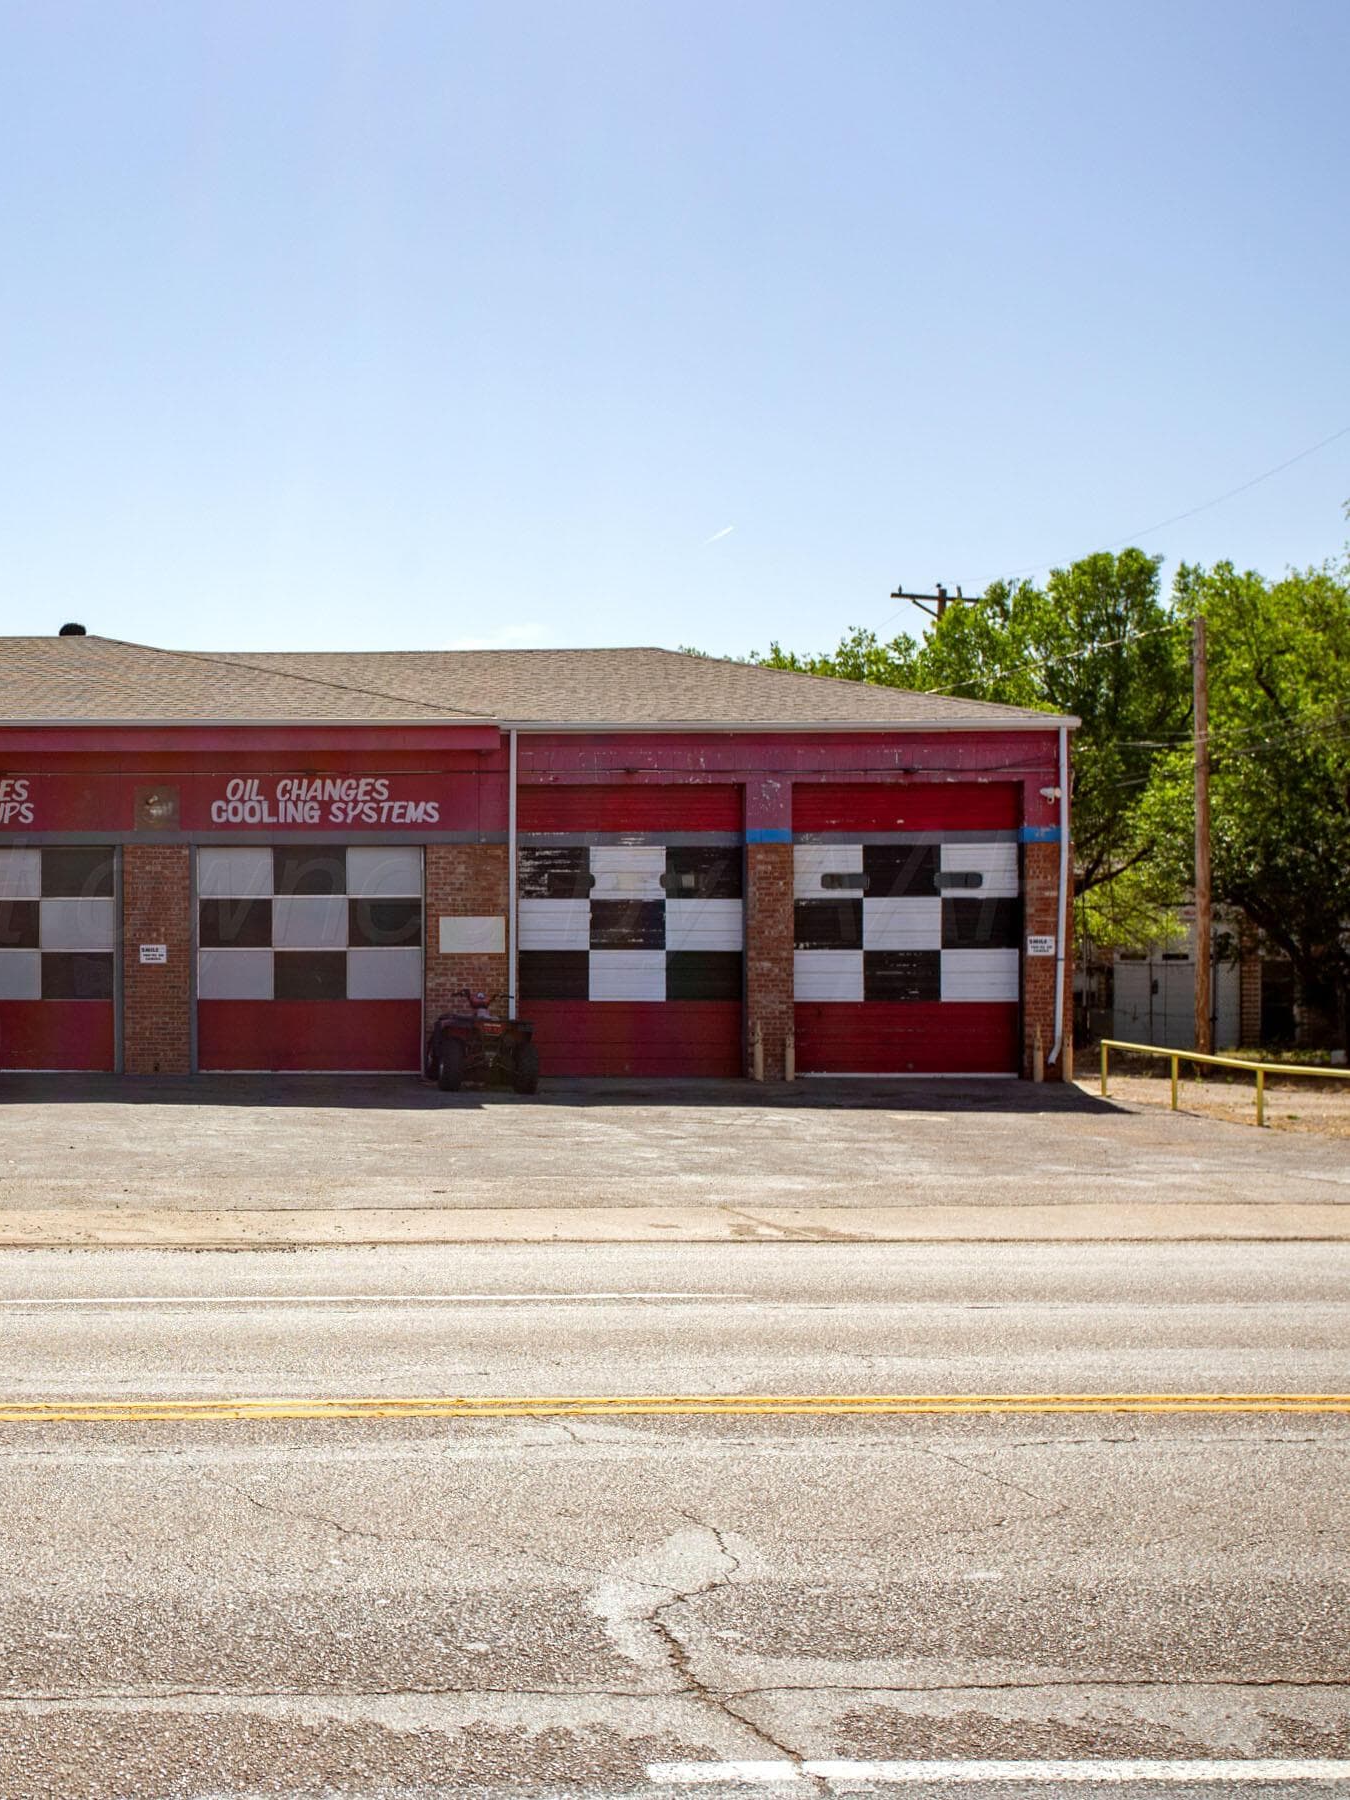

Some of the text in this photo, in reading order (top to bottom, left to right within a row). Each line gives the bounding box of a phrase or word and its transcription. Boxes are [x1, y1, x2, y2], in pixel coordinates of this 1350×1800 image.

[226, 778, 389, 801] OIL CHANGES
[211, 801, 440, 824] COOLING SYSTEMS
